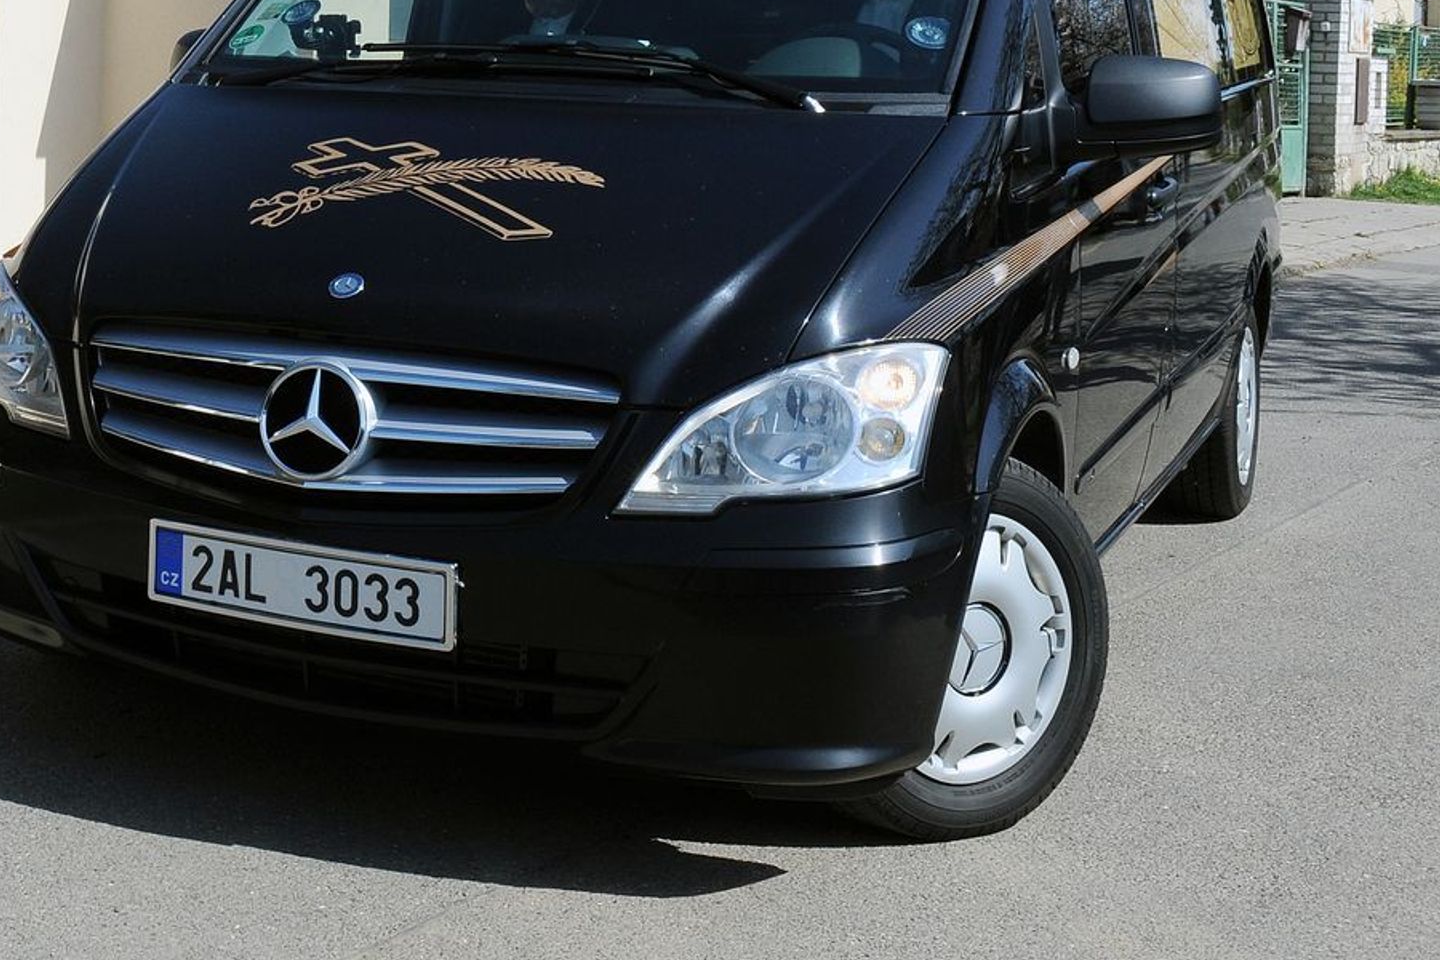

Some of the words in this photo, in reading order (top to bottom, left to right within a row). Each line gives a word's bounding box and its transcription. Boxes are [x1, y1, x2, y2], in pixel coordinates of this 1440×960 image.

[161, 570, 179, 587] CZ
[191, 544, 267, 604] 2AL
[304, 565, 421, 627] 3033
